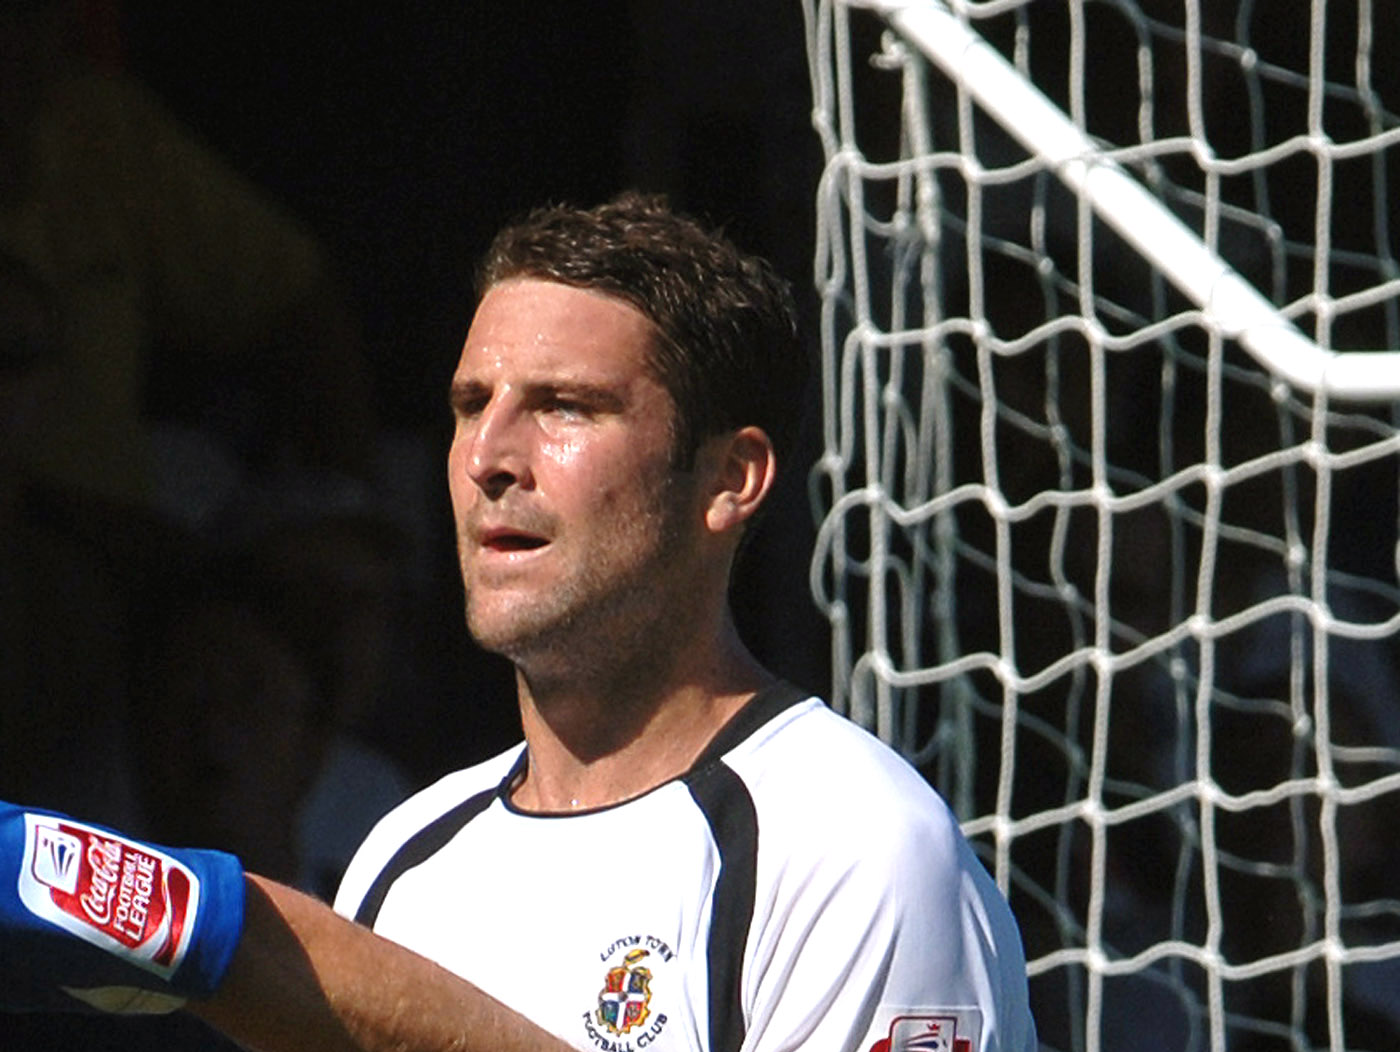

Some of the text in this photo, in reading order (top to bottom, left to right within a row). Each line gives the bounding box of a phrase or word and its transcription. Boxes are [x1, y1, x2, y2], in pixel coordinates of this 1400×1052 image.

[113, 851, 138, 932] FOOTBALL
[125, 855, 157, 941] LEAGUE
[636, 1012, 668, 1049] CLUB
